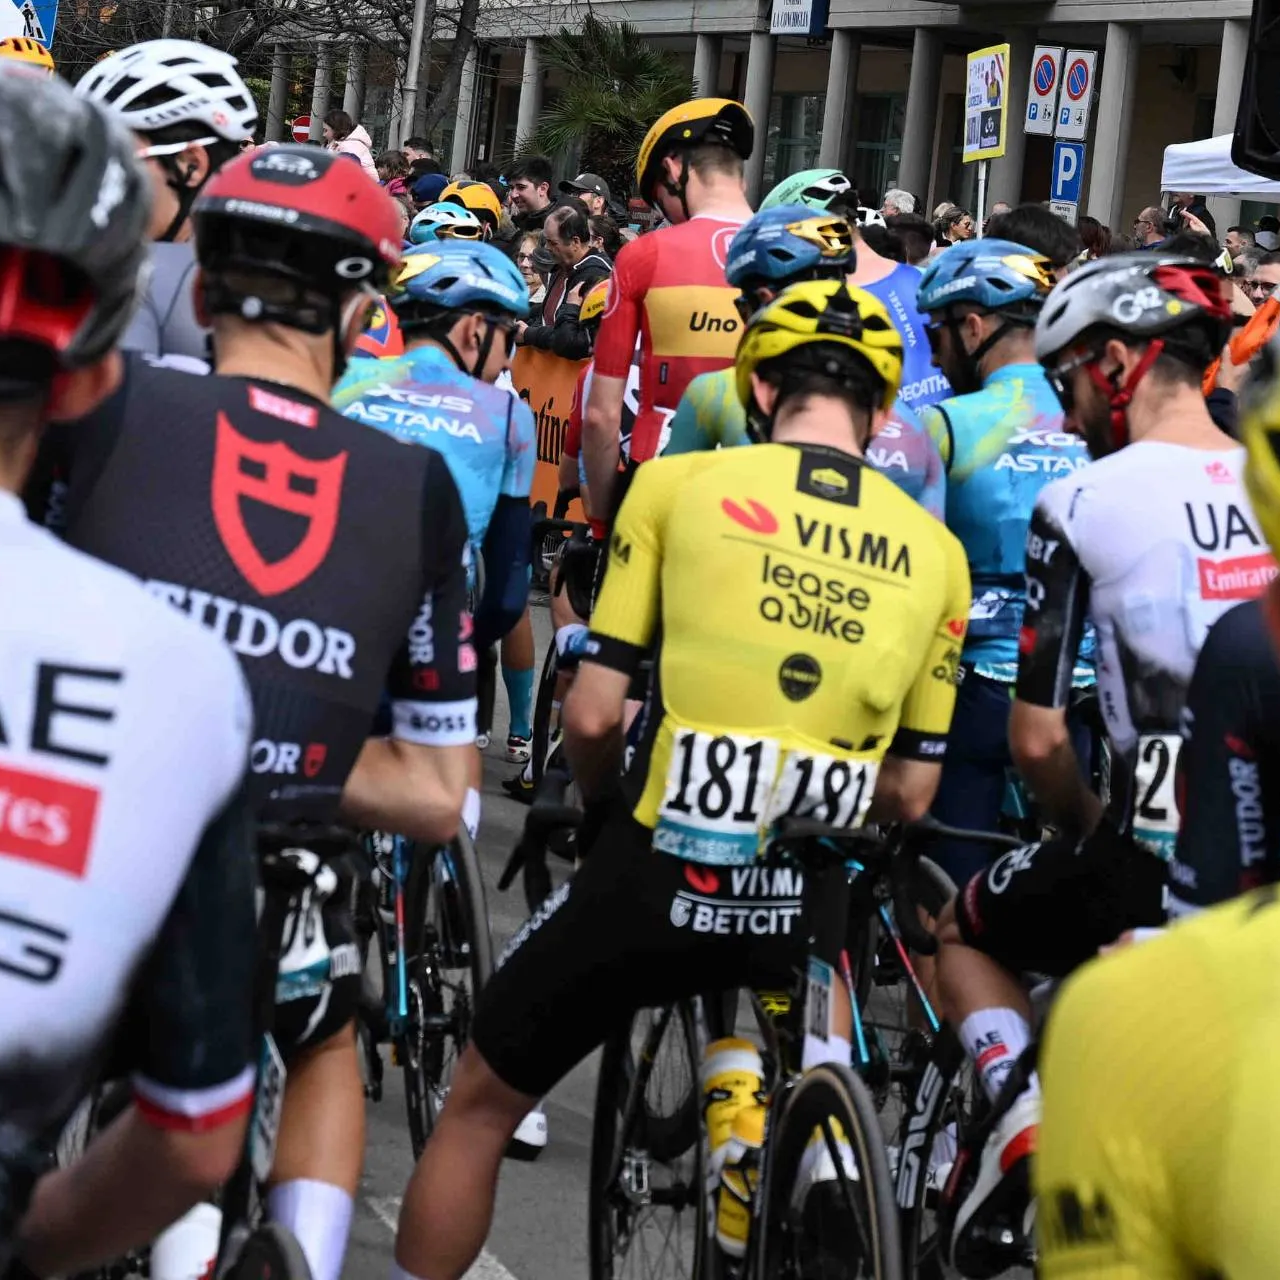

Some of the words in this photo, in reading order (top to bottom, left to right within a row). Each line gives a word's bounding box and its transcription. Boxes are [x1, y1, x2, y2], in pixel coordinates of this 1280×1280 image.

[1056, 147, 1078, 196] P
[688, 311, 738, 334] Uno
[341, 400, 484, 445] ASTANA
[993, 452, 1093, 473] ASTAN
[793, 512, 913, 579] VISMA
[1184, 501, 1261, 552] UA
[760, 553, 872, 613] lease
[666, 732, 764, 823] 181
[1227, 757, 1267, 867] TUDOR
[692, 905, 803, 935] BETCIT
